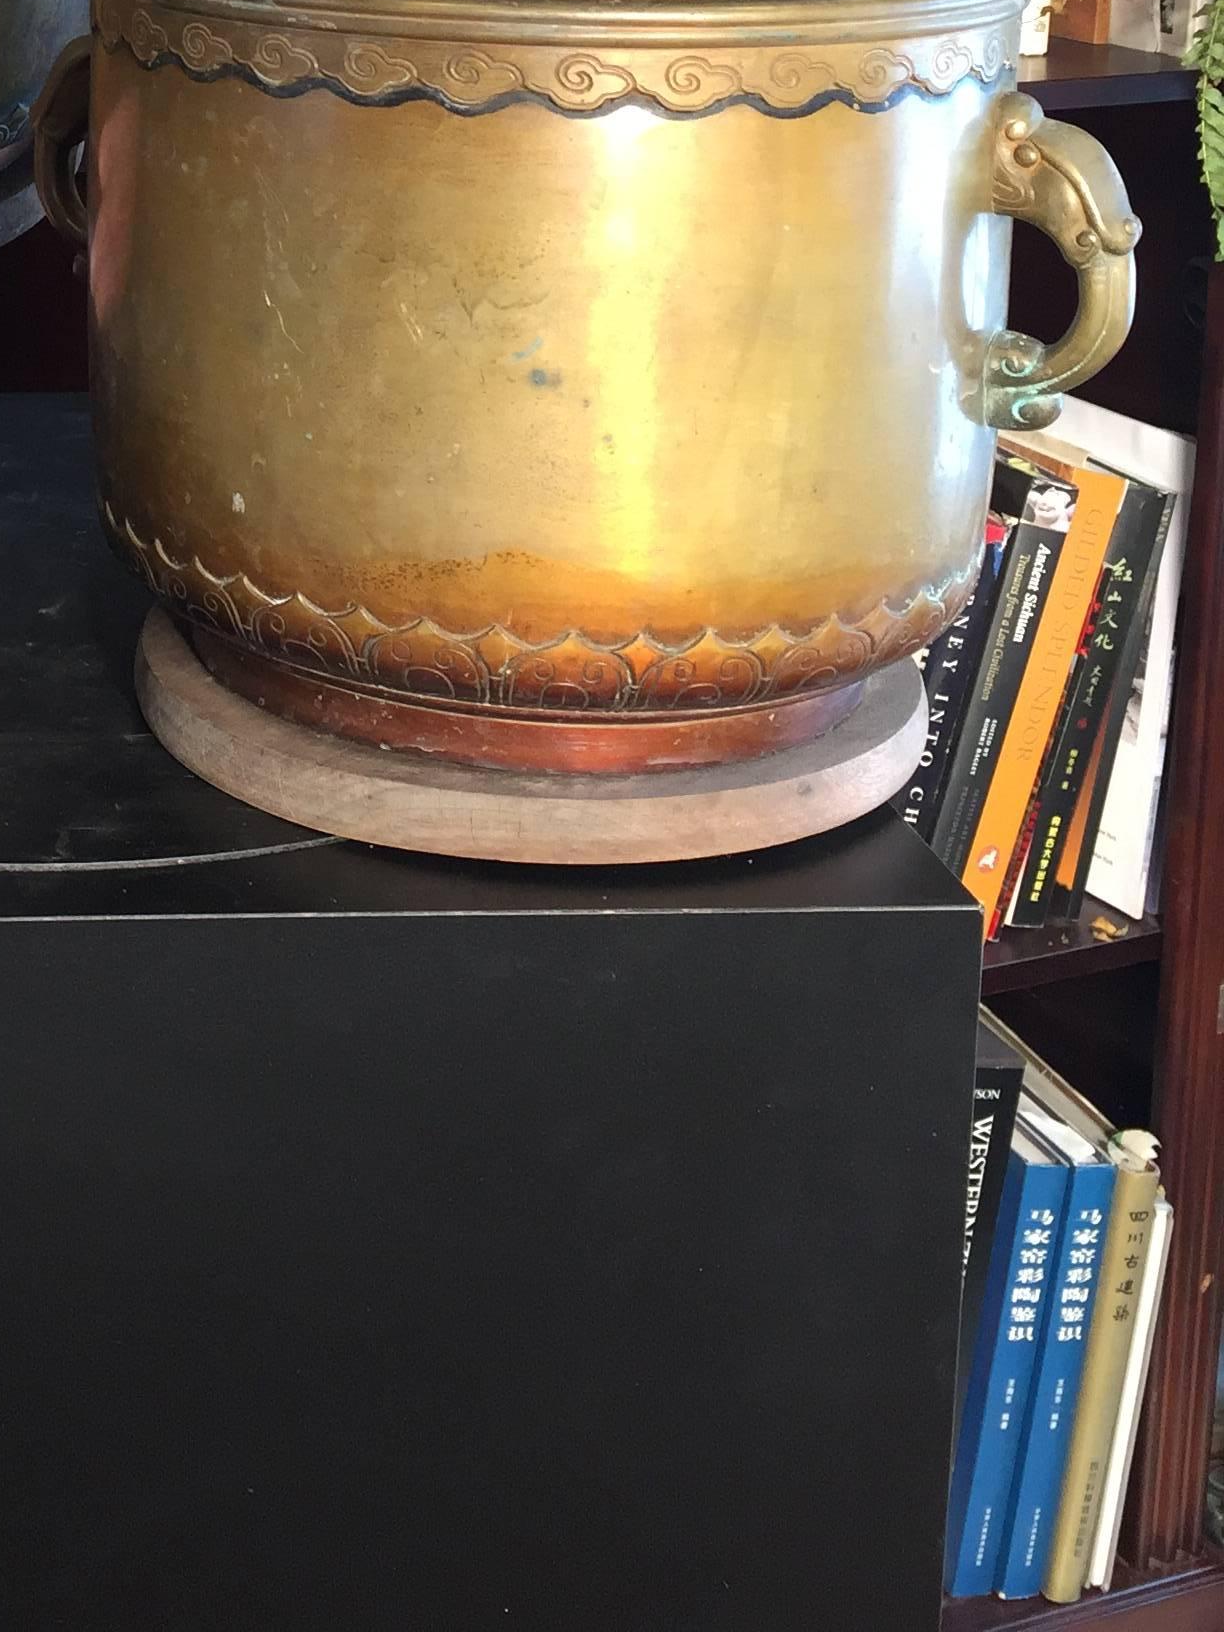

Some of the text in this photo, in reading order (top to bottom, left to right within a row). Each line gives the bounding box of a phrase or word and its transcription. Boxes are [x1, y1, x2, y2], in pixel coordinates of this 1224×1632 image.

[1010, 552, 1031, 596] Treasures
[1012, 543, 1052, 644] Ancient Sichuan
[1000, 593, 1019, 619] from
[995, 628, 1009, 647] Lost
[980, 647, 1004, 702] Civilization
[1016, 619, 1069, 763] SPLENDOR
[917, 692, 949, 768] INTO
